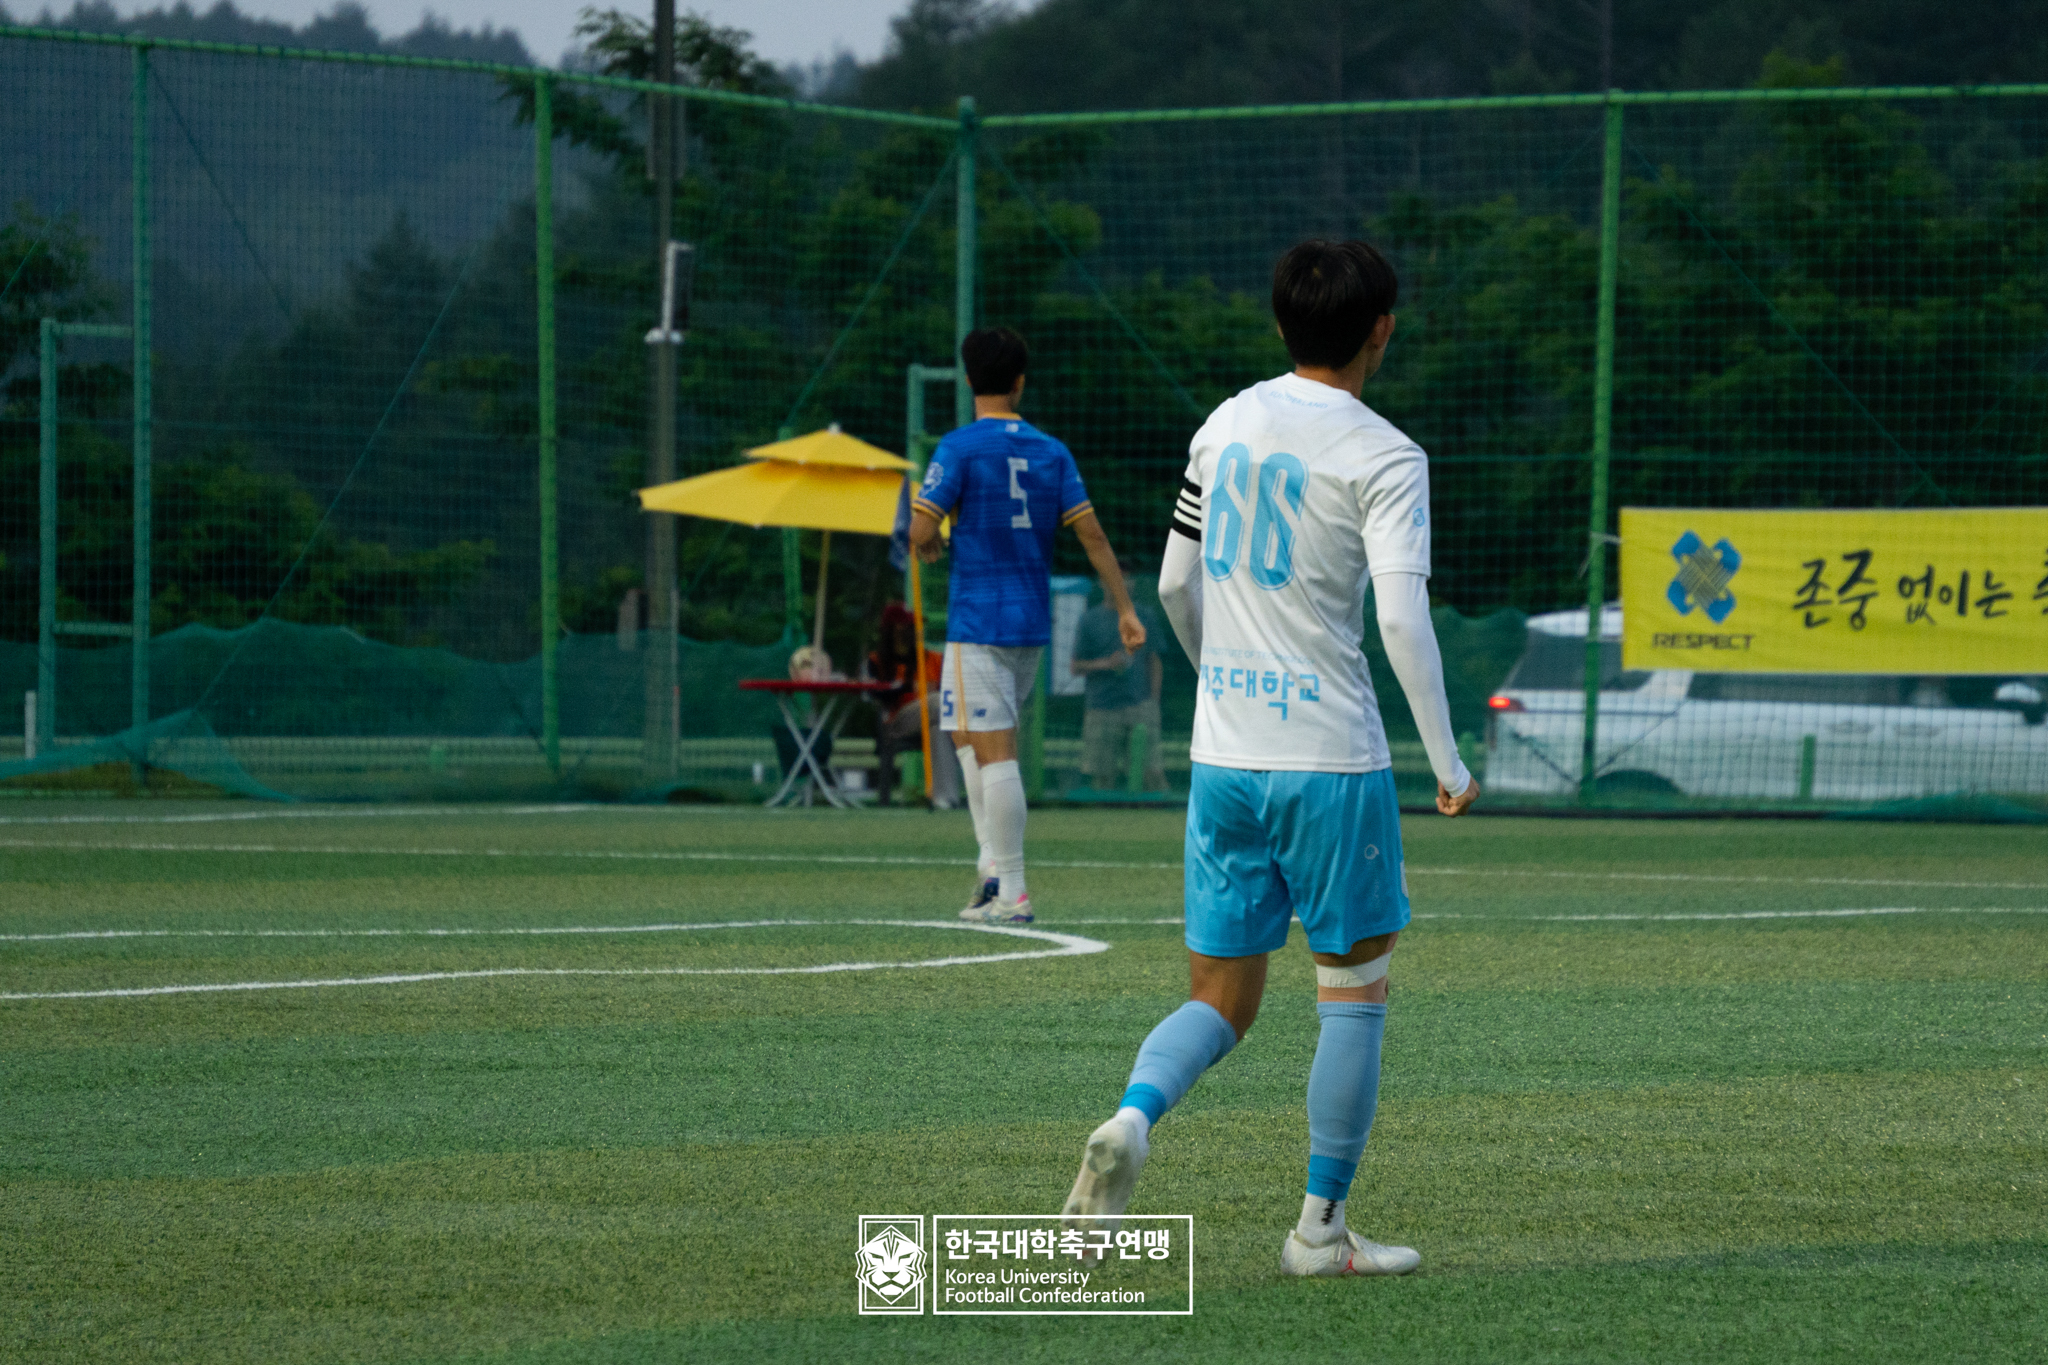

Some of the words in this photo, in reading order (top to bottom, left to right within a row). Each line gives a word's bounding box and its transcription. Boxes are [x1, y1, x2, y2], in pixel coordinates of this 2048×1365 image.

[1007, 457, 1032, 528] 5
[1793, 549, 1879, 631] 존중
[1897, 564, 2014, 626] 없이는
[1651, 632, 1755, 651] RESPECT
[943, 690, 954, 717] 5
